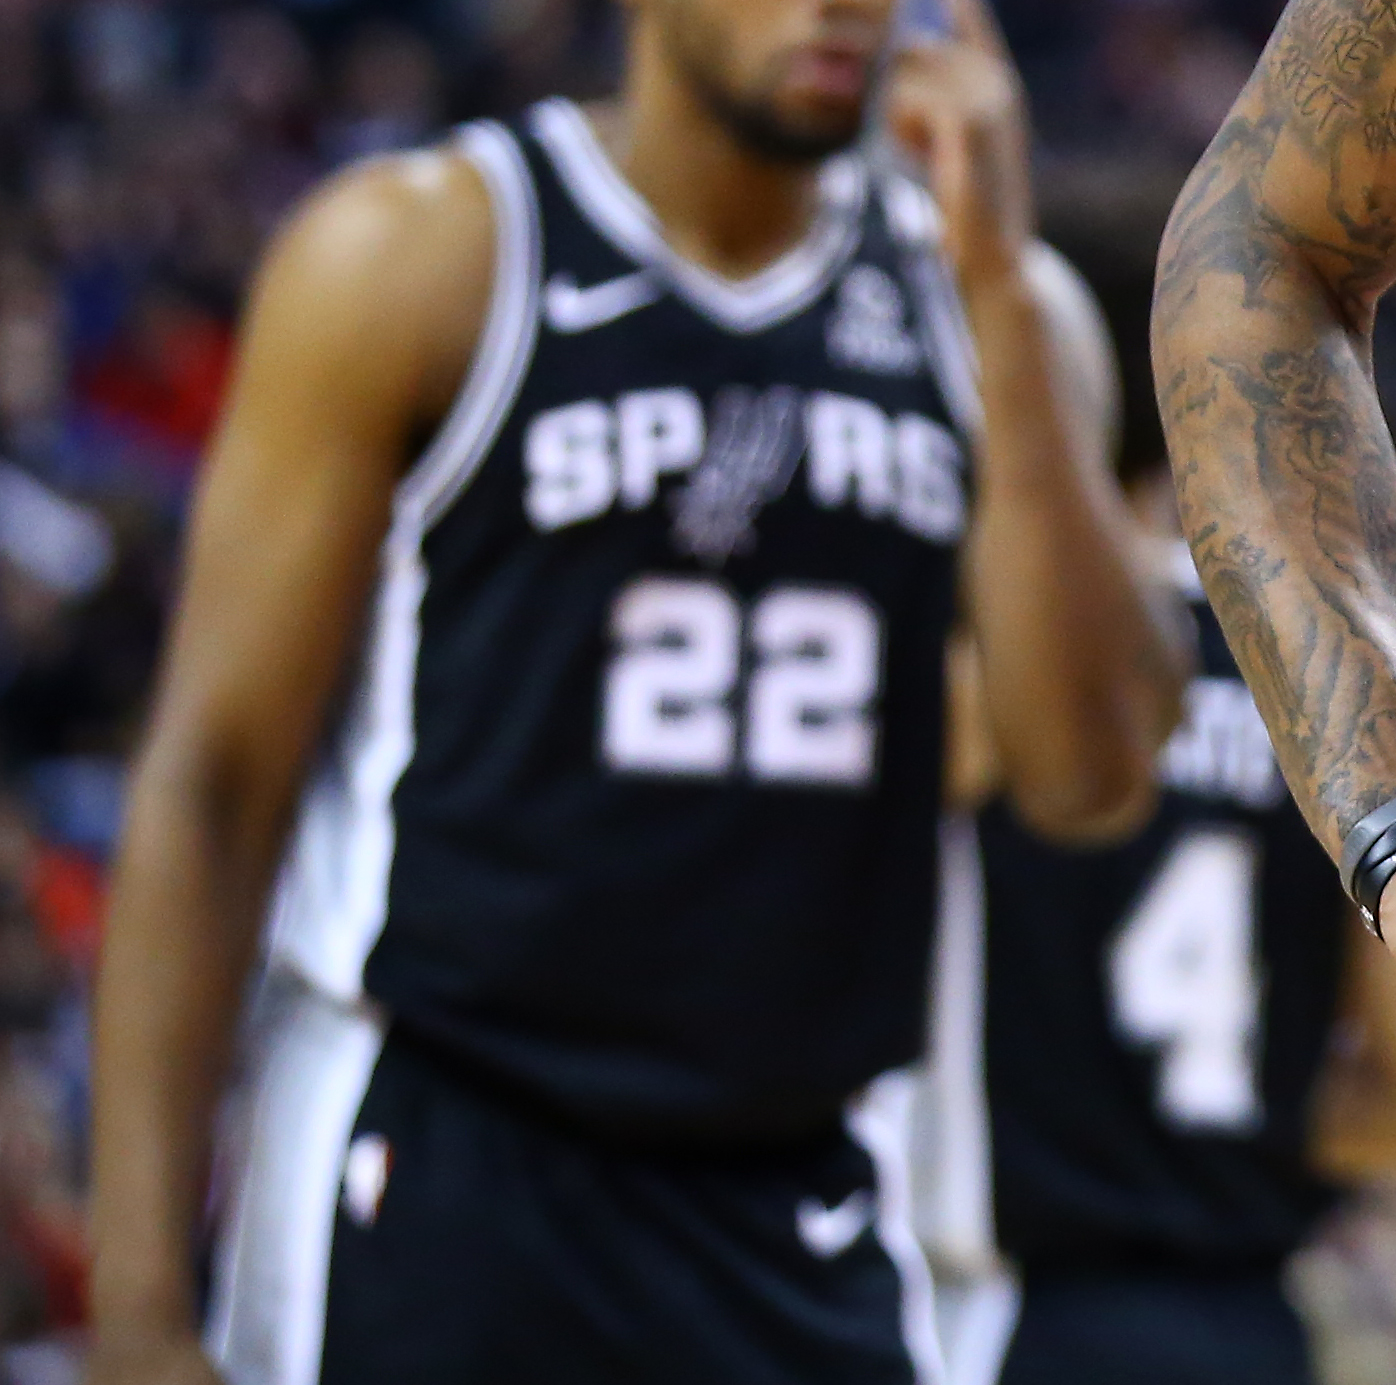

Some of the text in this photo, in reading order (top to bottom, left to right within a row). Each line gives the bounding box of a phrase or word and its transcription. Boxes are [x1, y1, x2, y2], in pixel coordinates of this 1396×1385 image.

[524, 383, 970, 545] SPURS
[602, 570, 884, 787] 22
[1106, 827, 1264, 1130] 4
